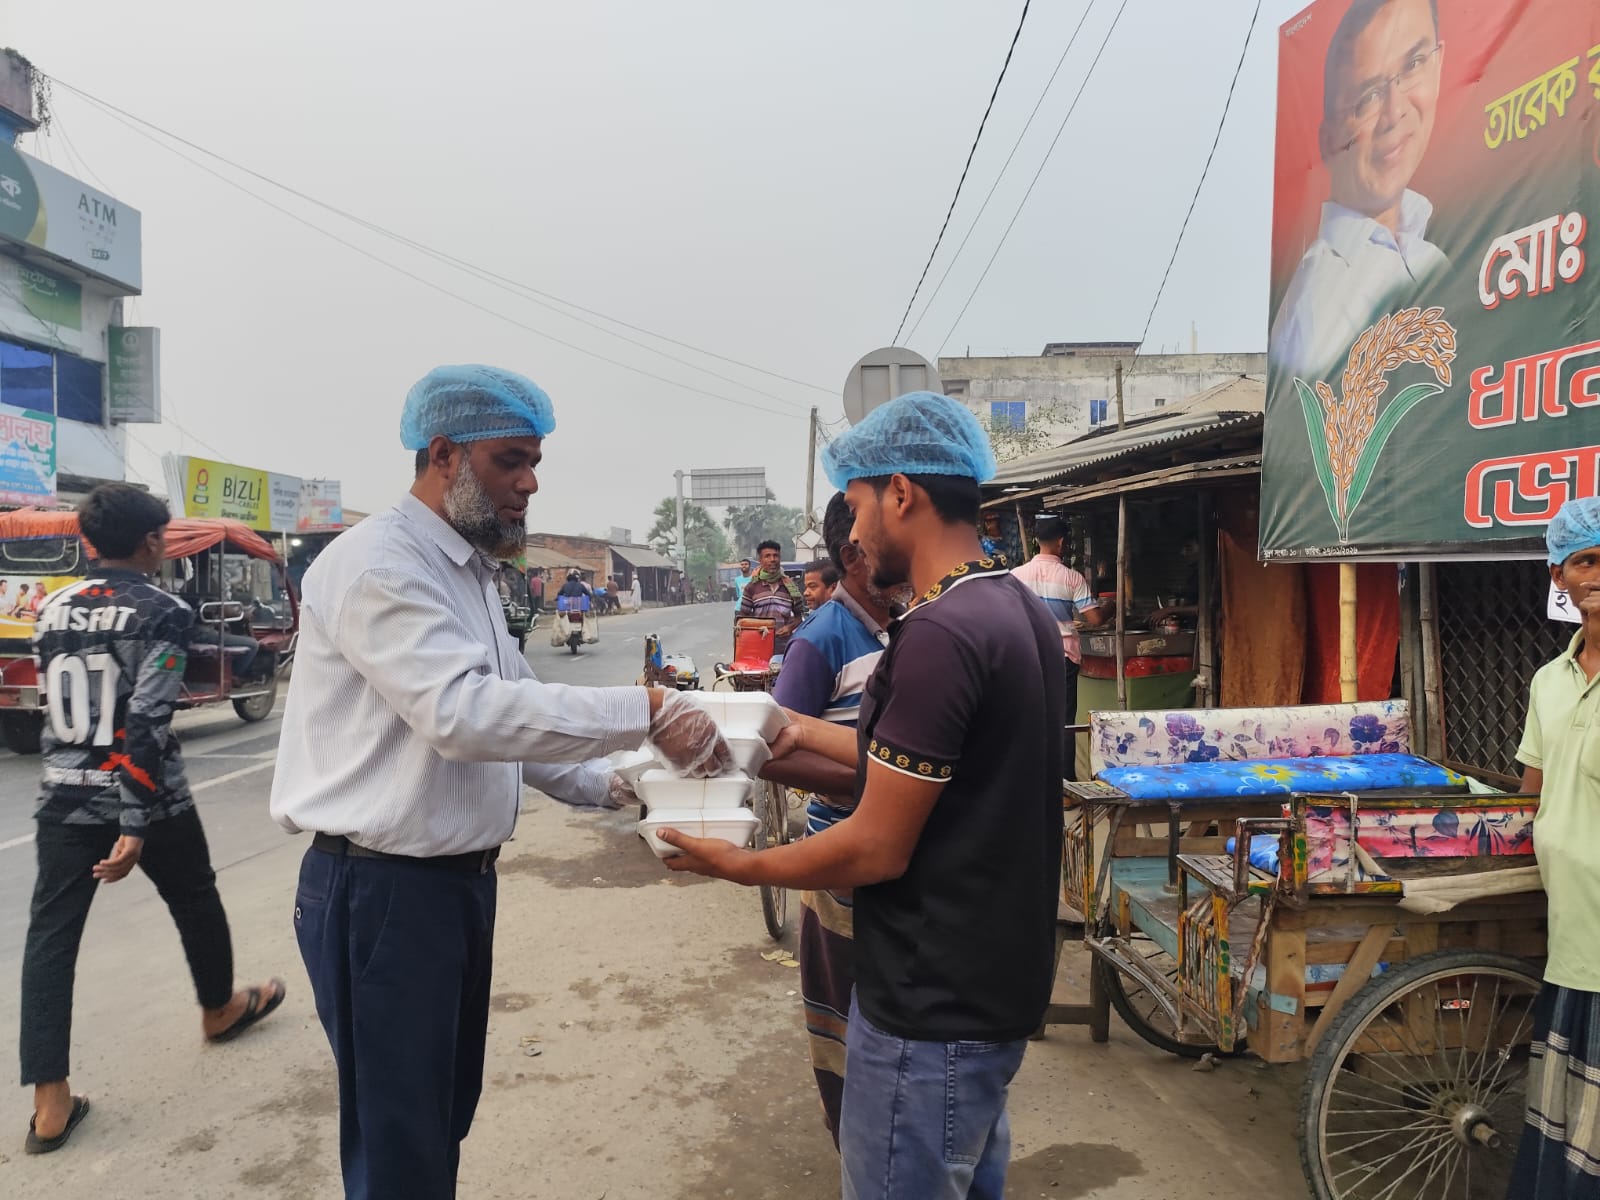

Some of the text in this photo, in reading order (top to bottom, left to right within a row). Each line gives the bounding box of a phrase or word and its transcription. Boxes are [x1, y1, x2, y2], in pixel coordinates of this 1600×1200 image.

[1483, 55, 1580, 149] তারেক
[78, 193, 117, 227] ATM
[1478, 211, 1587, 309] মোঃ
[1463, 446, 1600, 528] ভো
[47, 653, 120, 745] 07
